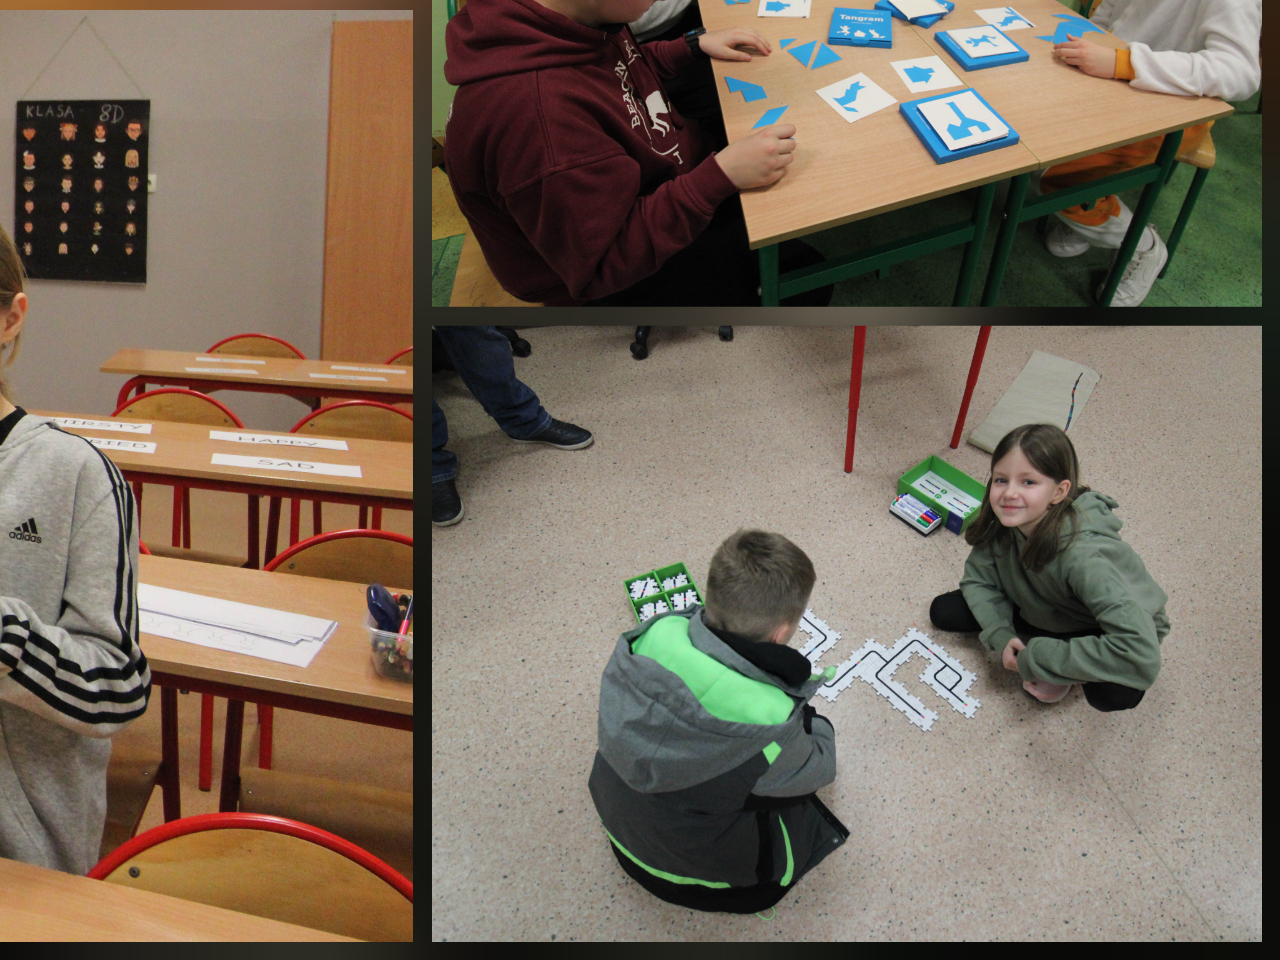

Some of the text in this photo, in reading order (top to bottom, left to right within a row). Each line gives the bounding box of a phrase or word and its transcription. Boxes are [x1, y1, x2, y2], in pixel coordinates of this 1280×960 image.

[839, 13, 884, 23] Tangram
[26, 103, 125, 124] KLASA 8D
[53, 418, 143, 430] HIRSTY
[88, 439, 147, 449] RIED
[238, 436, 318, 446] HAPPY
[258, 459, 315, 470] SAD
[8, 530, 42, 544] adidas
